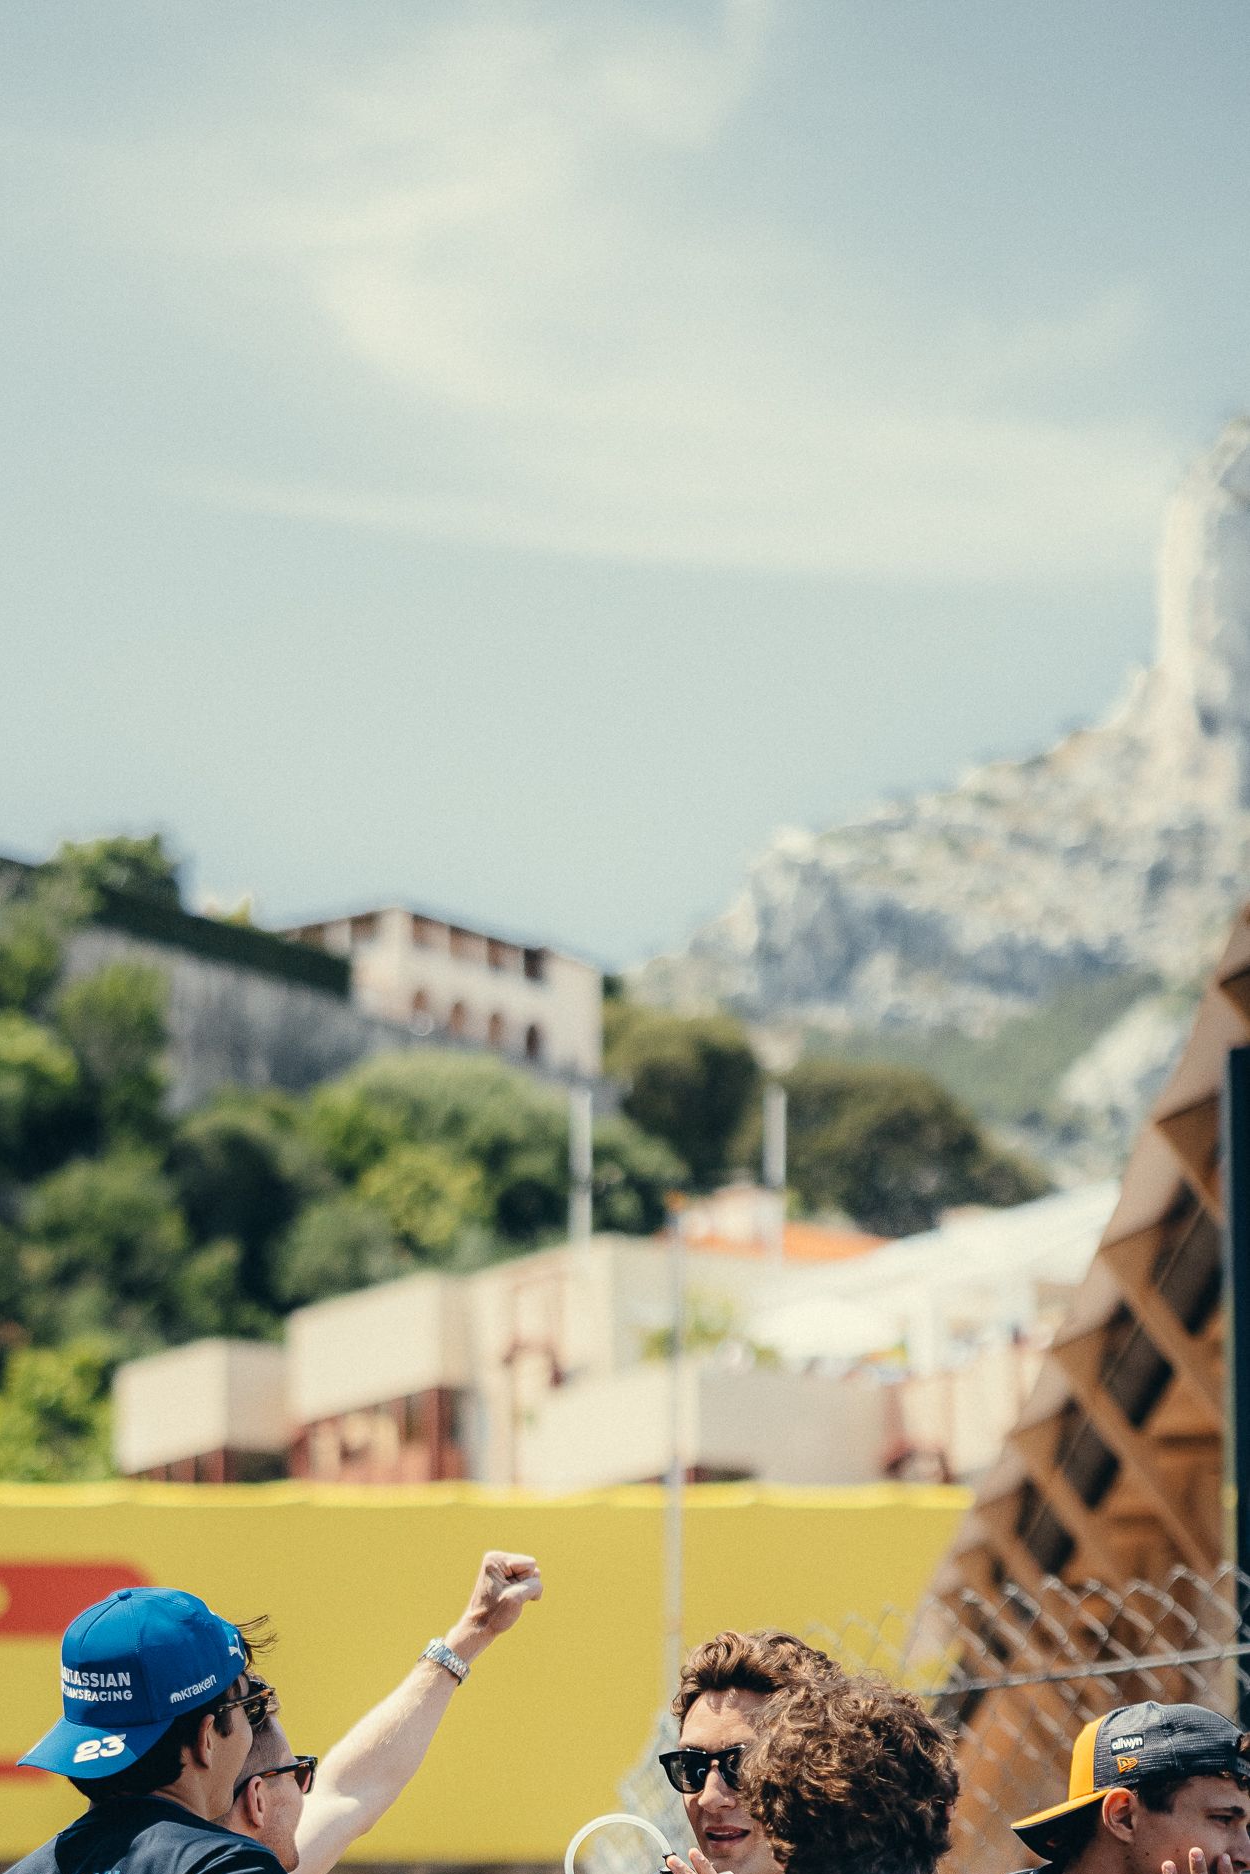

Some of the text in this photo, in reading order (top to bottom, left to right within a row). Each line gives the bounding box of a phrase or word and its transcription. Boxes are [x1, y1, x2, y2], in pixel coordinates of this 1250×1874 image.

[180, 1674, 217, 1699] kraken
[73, 1734, 127, 1764] 23
[1111, 1736, 1143, 1751] allwyn
